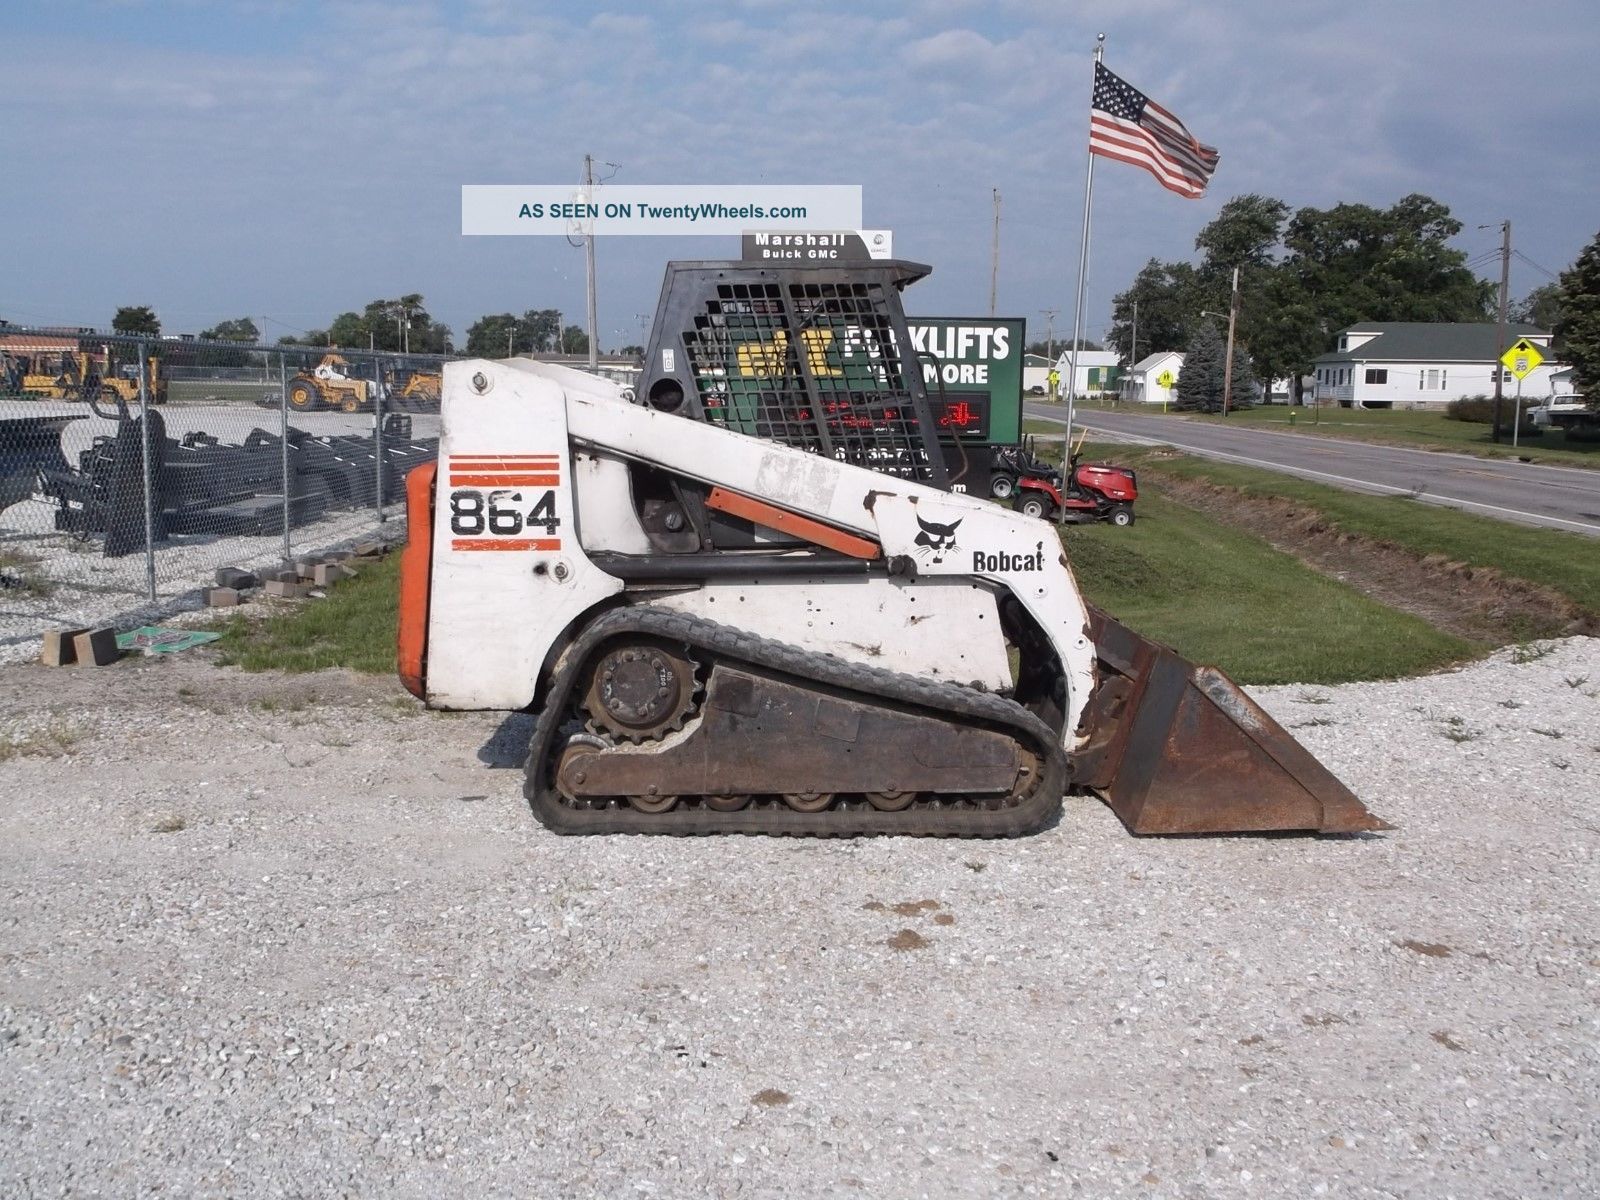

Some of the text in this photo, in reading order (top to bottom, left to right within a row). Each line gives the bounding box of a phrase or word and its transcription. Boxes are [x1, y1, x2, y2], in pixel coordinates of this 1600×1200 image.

[755, 232, 845, 247] Marshall
[762, 249, 838, 259] Buick GMC
[923, 363, 988, 385] MORE
[449, 489, 561, 536] 864
[973, 550, 1044, 573] Bobcat
